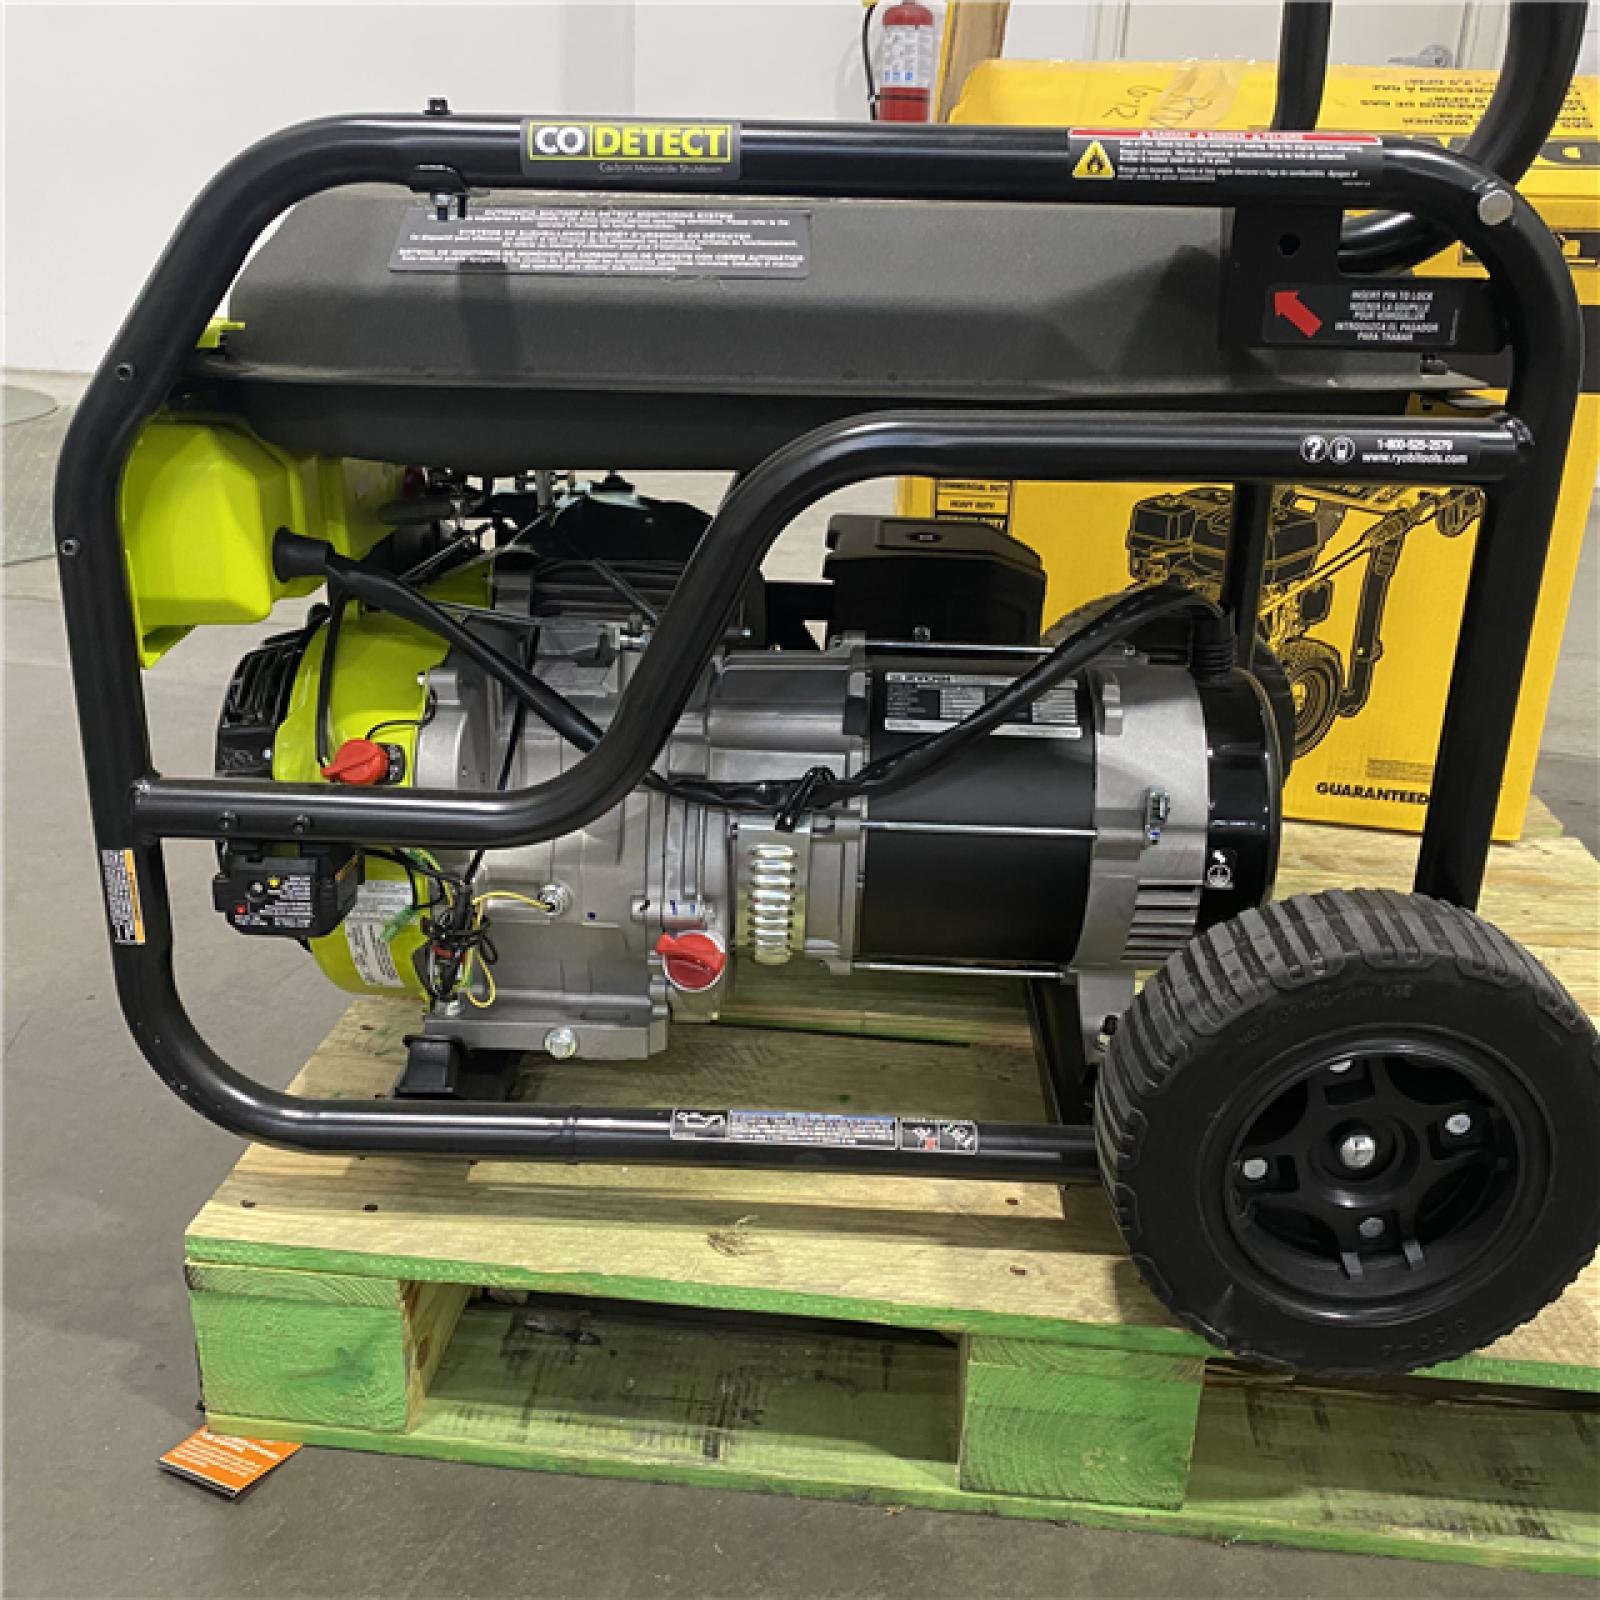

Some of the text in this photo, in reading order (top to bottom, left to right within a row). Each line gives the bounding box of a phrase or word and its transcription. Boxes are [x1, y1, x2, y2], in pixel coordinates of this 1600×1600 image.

[535, 126, 726, 157] CO DETECT
[1361, 452, 1469, 466] www.ryobitools.com
[1316, 781, 1430, 806] GUARANTEED
